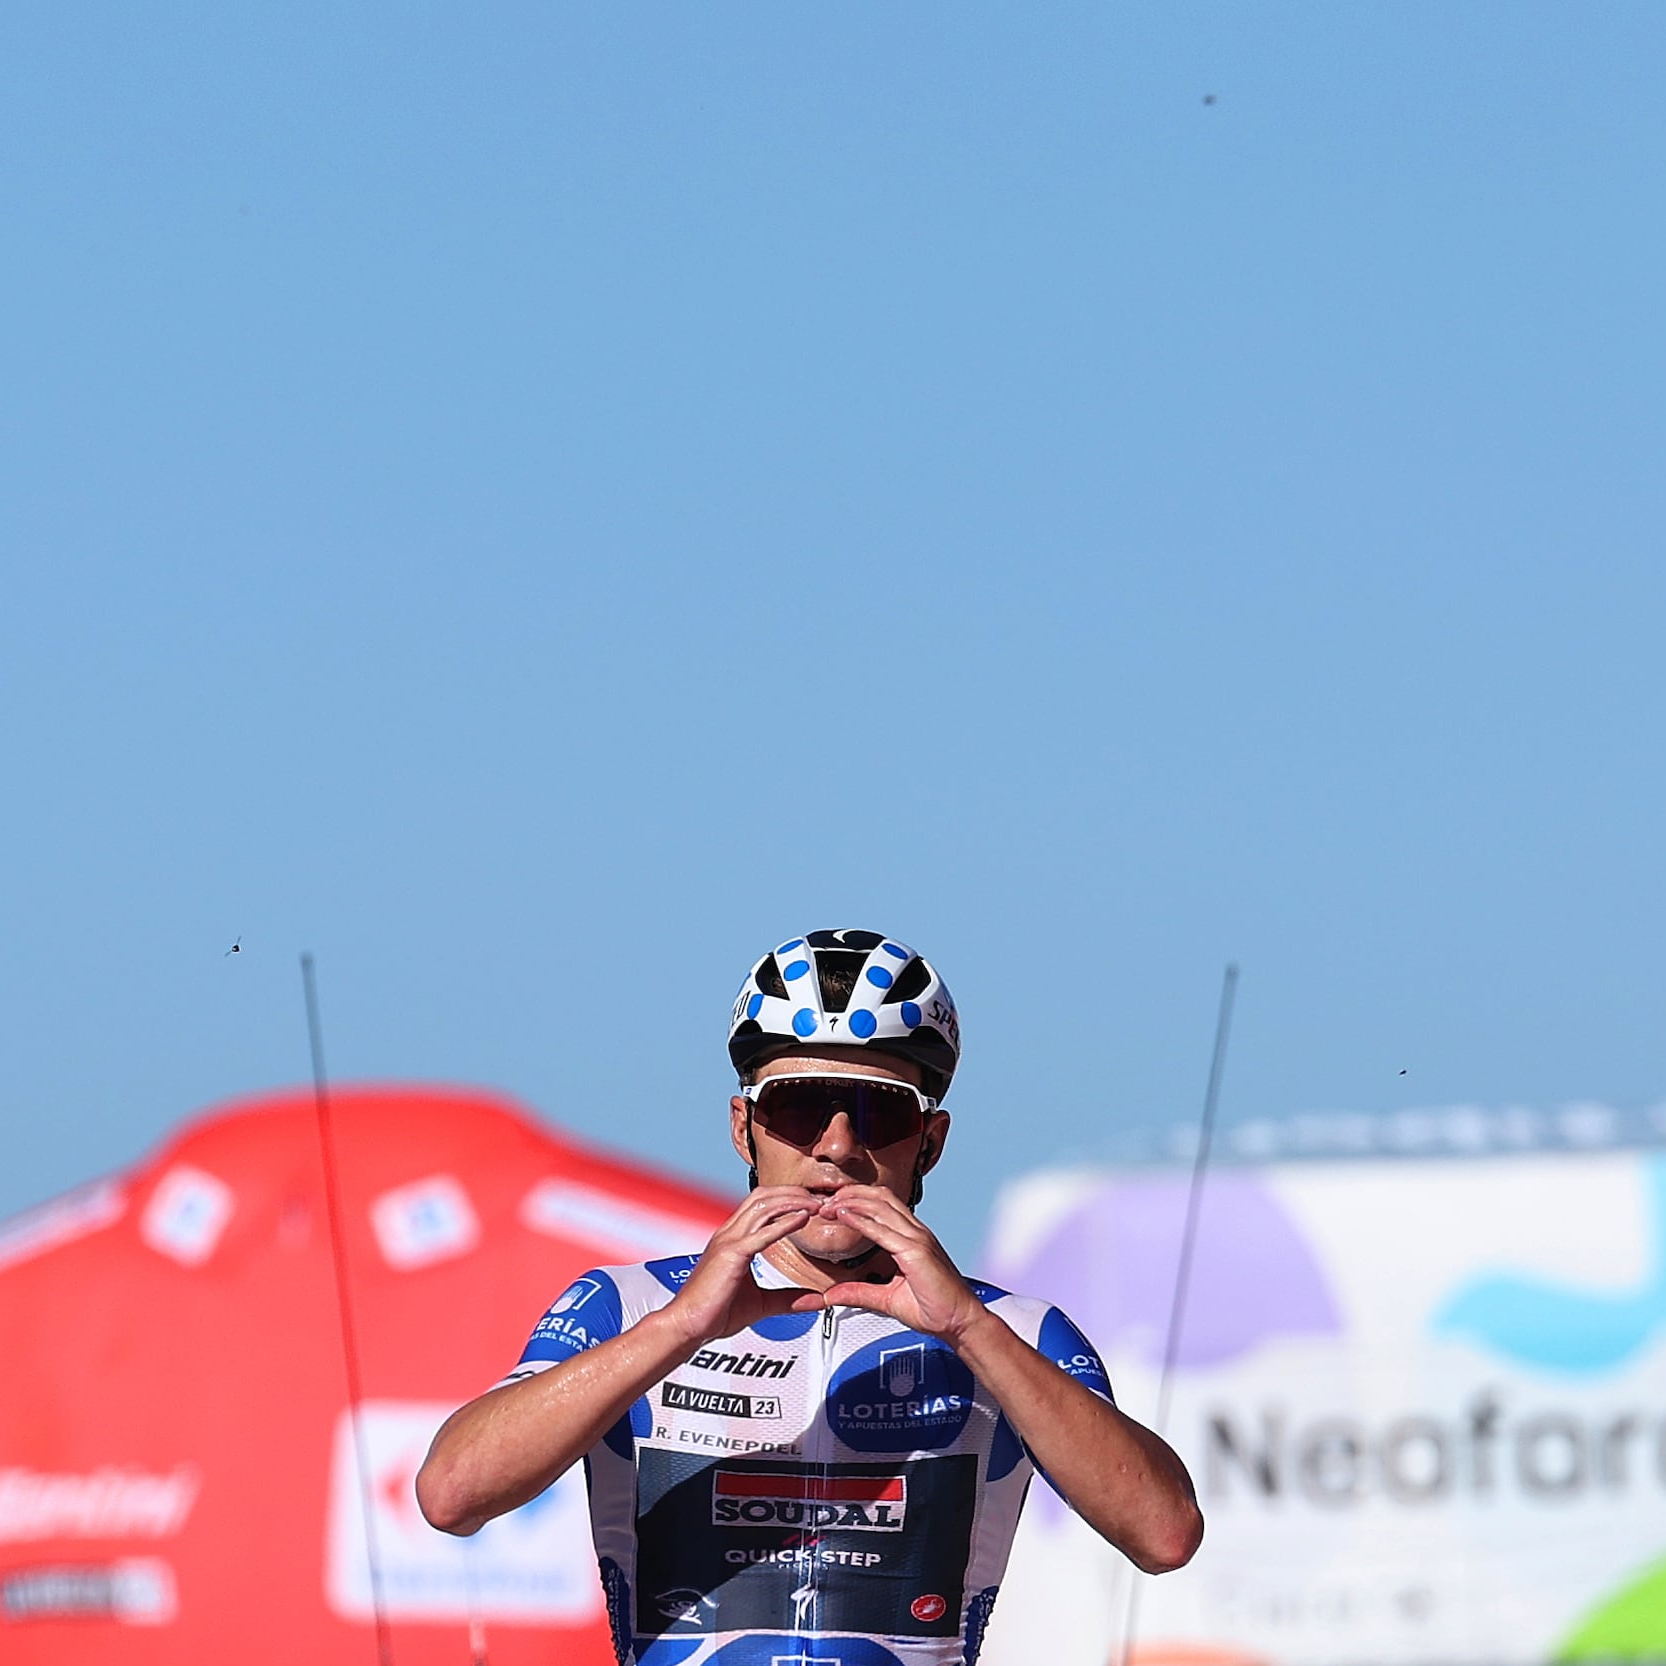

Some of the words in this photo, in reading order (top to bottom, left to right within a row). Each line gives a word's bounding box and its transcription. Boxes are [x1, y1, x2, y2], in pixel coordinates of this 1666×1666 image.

[683, 1348, 799, 1380] antini
[667, 1387, 686, 1406] LA
[688, 1391, 746, 1414] VUELTA
[754, 1399, 777, 1416] 23
[655, 1425, 673, 1442] R.
[678, 1429, 803, 1456] EVENEPOEL
[714, 1499, 901, 1529] SOUDAL
